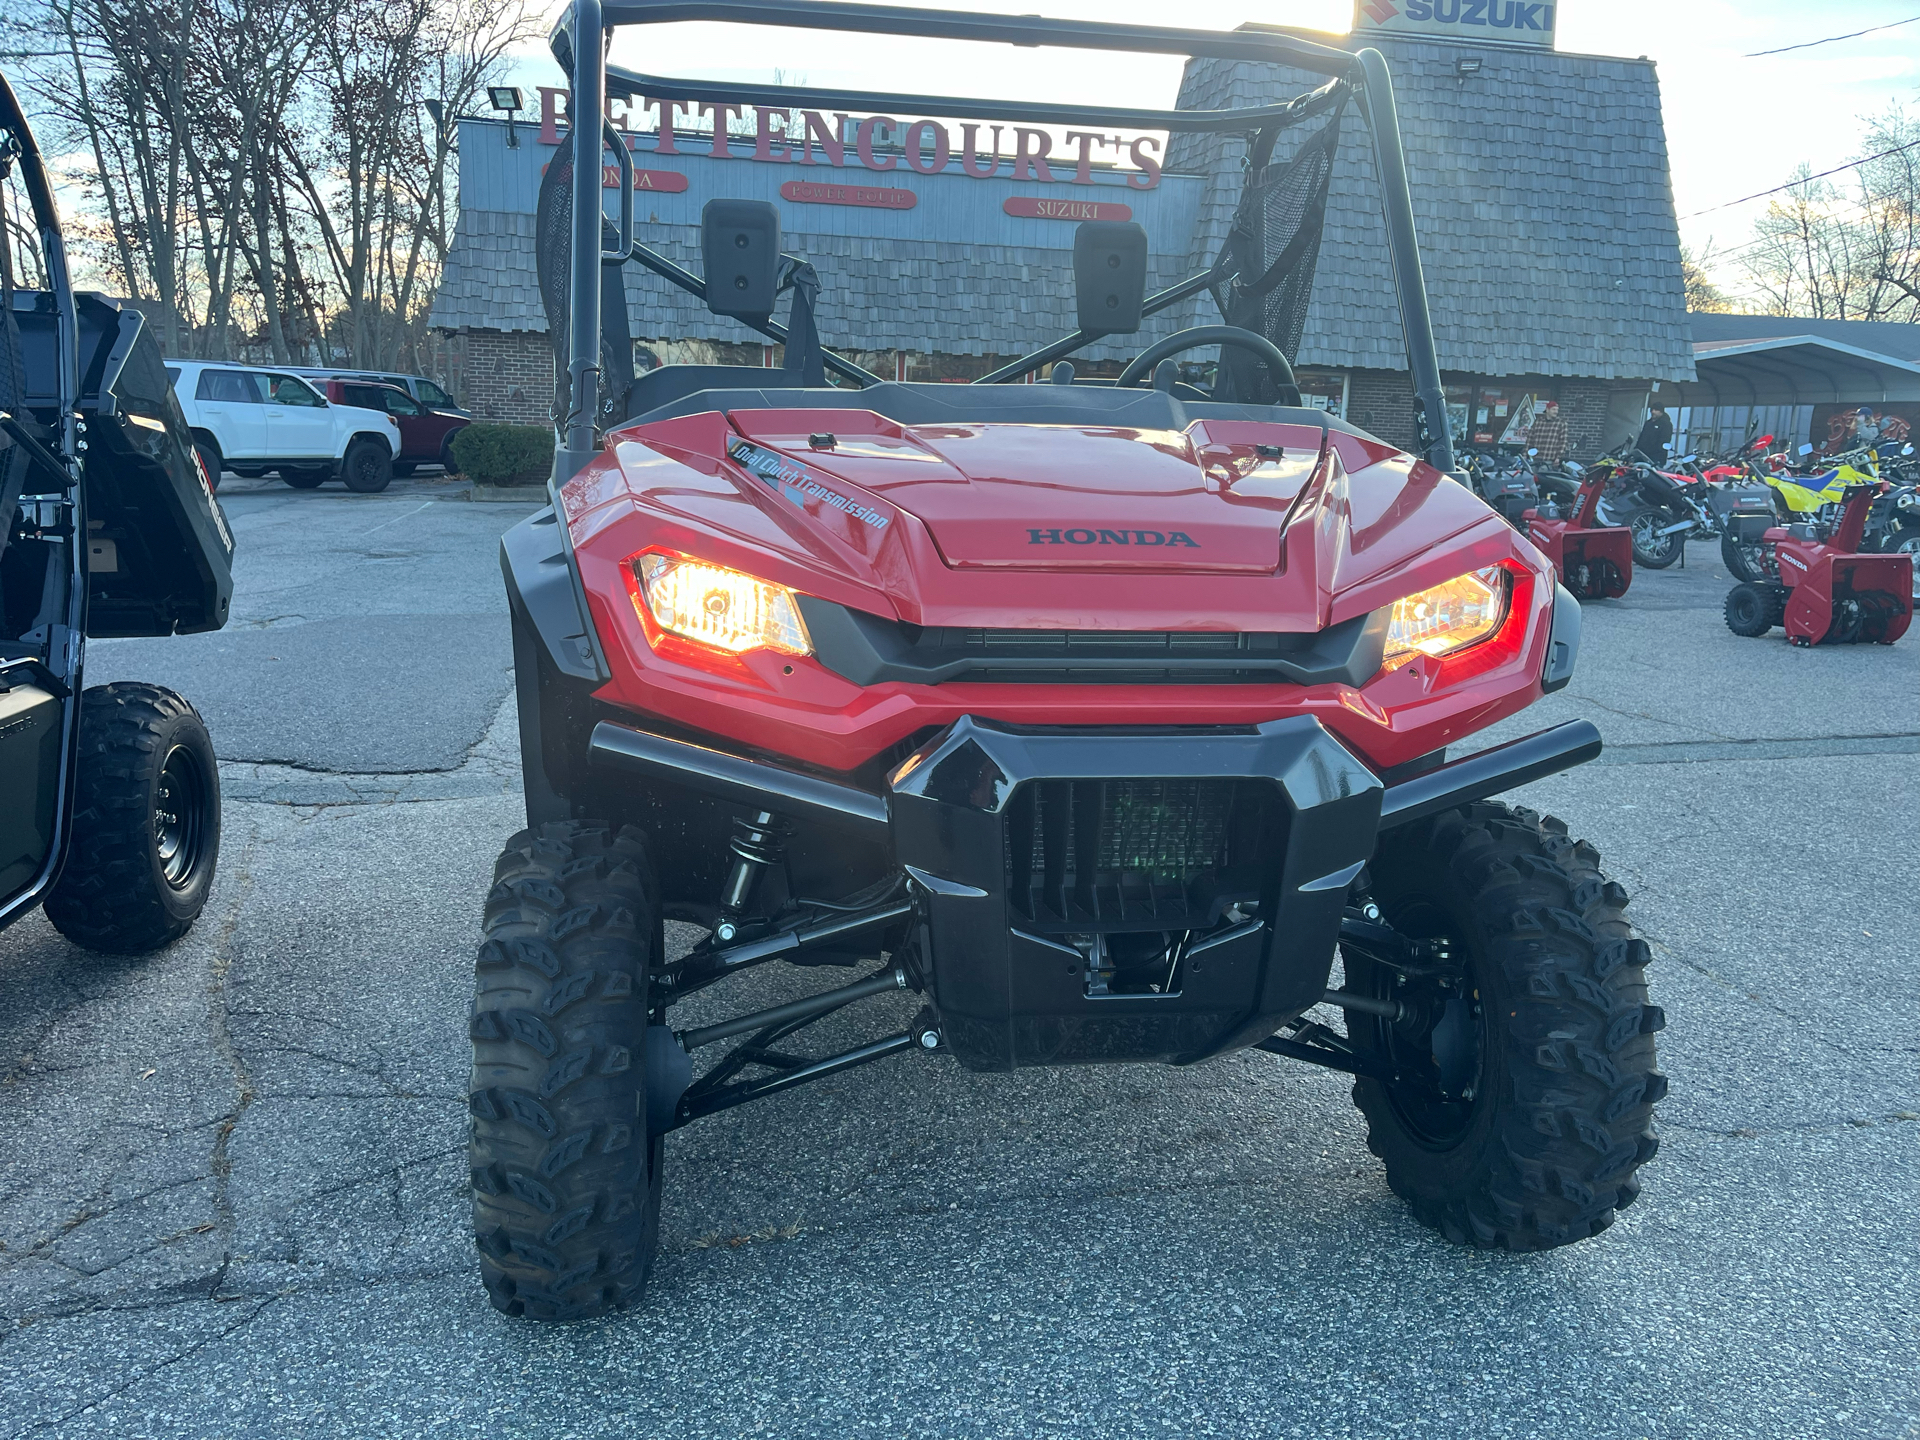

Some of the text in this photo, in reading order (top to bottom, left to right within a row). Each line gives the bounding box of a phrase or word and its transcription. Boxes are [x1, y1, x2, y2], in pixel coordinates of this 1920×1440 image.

[1405, 0, 1554, 31] SUZUKI
[792, 185, 846, 200] POWER
[1036, 201, 1098, 219] SUZUKI
[733, 445, 889, 529] Dual Clutch Transmission
[190, 444, 232, 555] PIONEER
[1026, 528, 1202, 548] HONDA
[1781, 552, 1808, 572] HONDA
